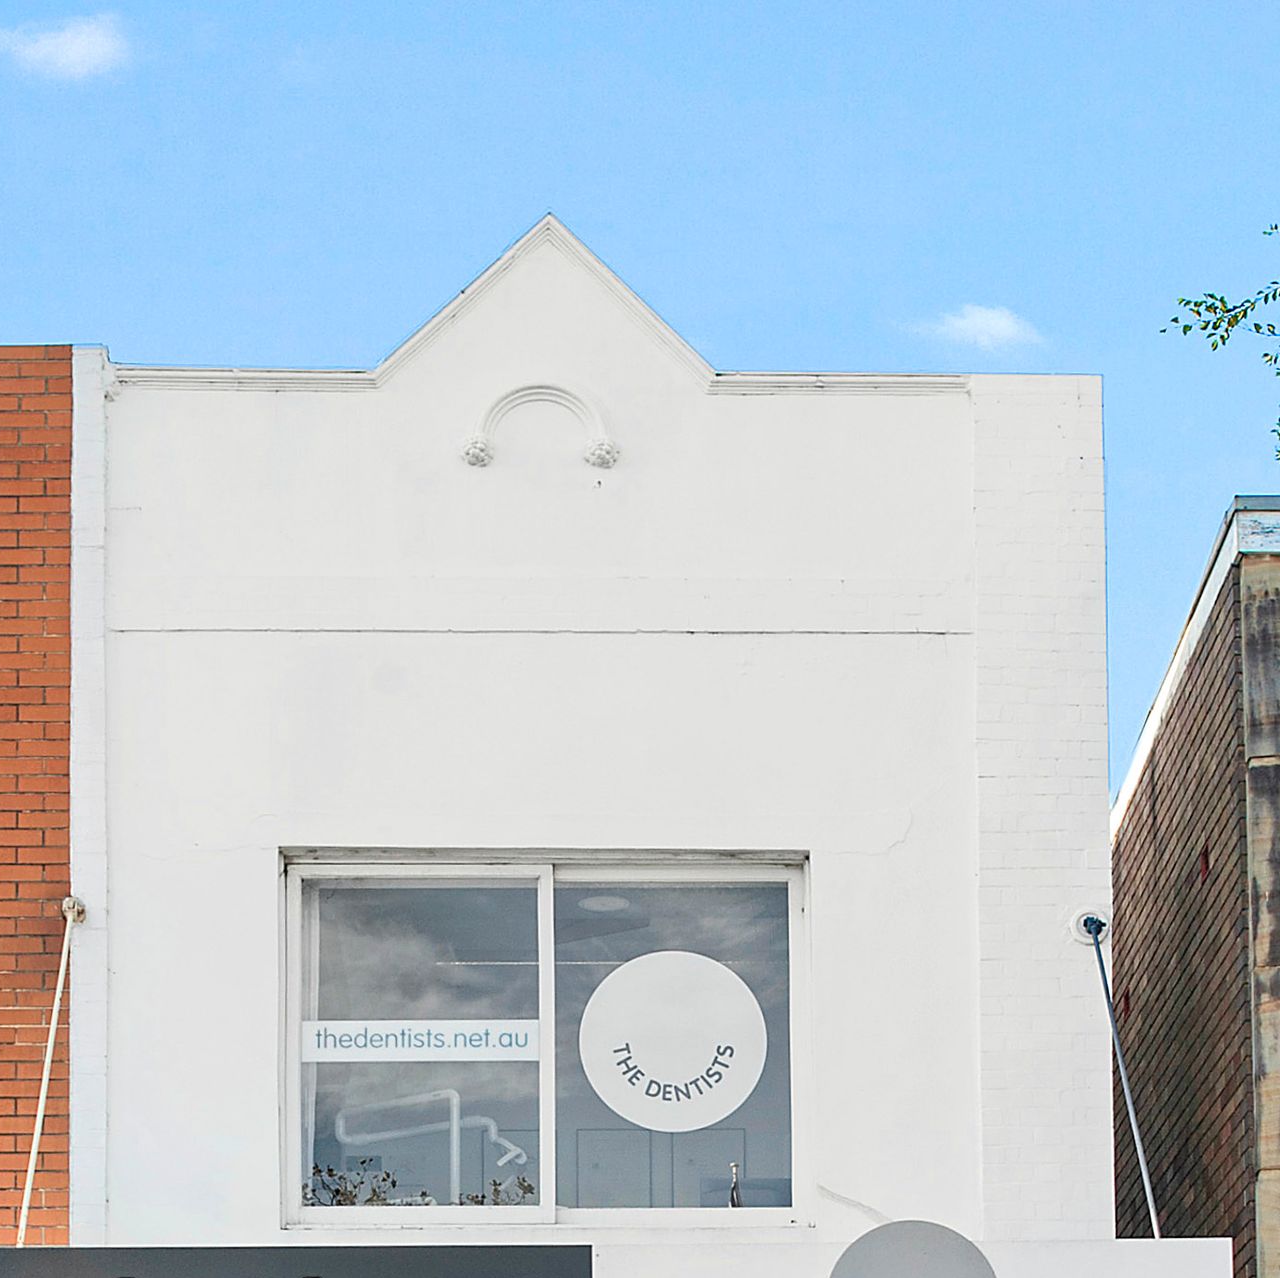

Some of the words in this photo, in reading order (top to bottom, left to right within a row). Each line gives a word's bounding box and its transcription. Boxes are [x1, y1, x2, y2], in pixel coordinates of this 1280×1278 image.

[315, 1027, 528, 1048] thedentists.net.au
[613, 1043, 645, 1085] THE
[645, 1044, 735, 1102] DENTISTS
